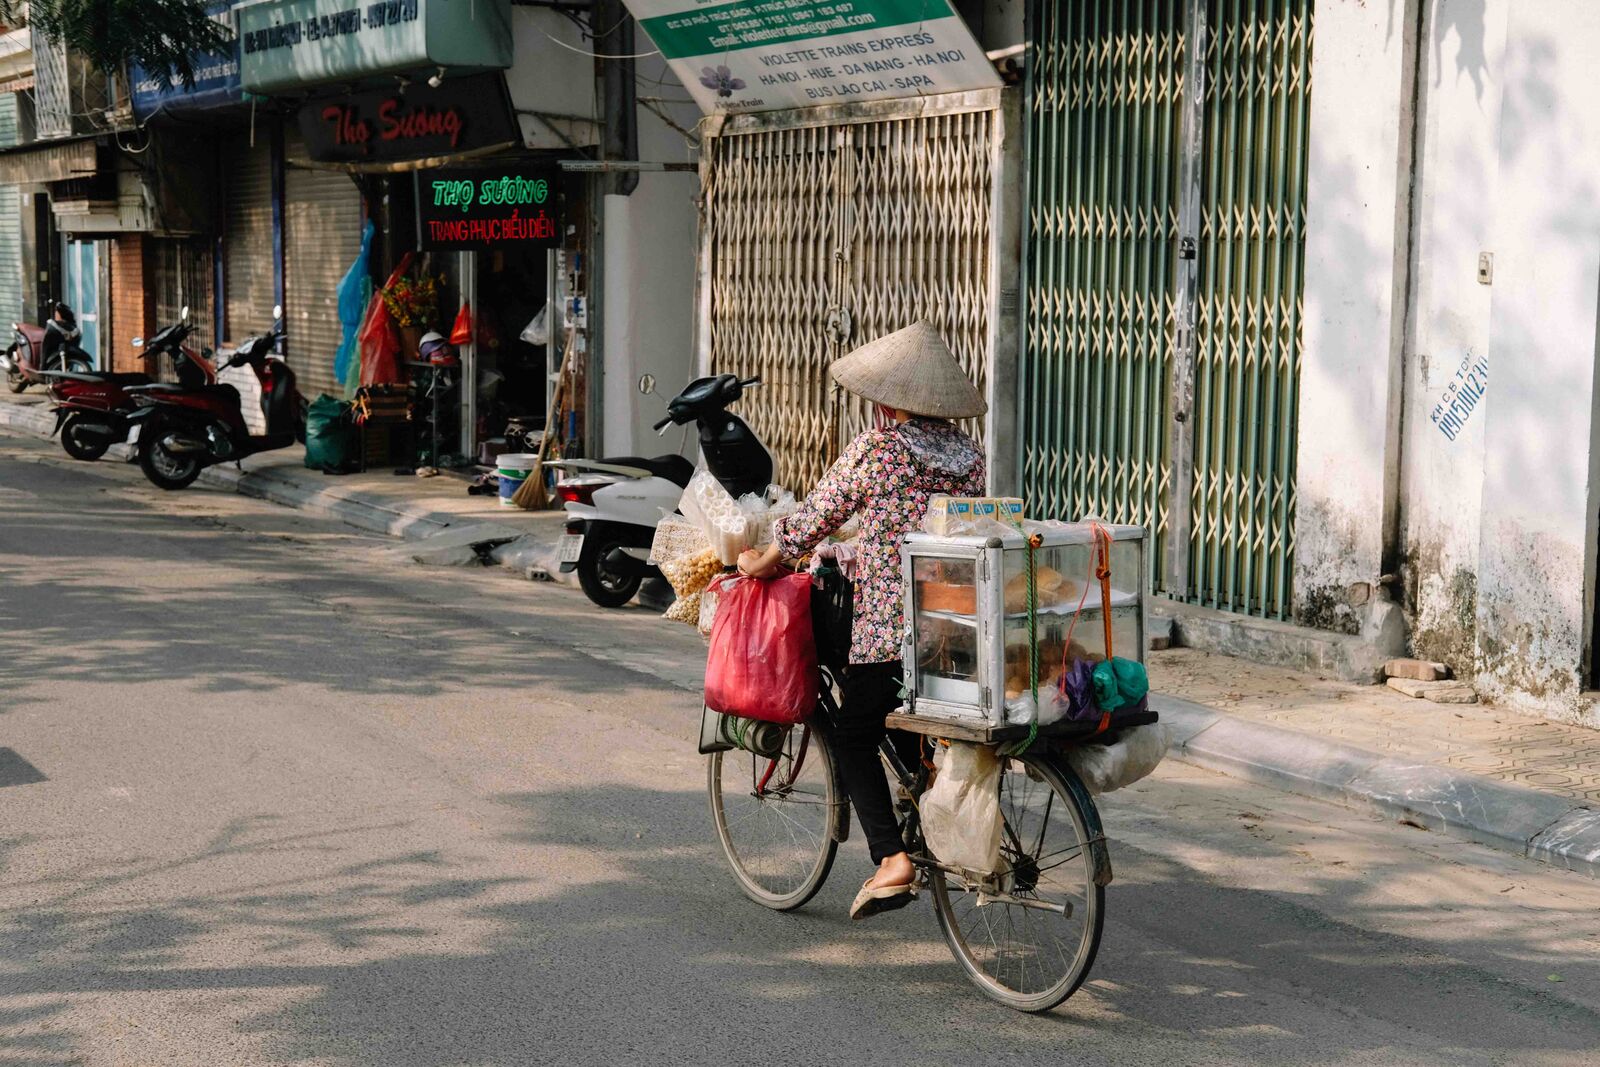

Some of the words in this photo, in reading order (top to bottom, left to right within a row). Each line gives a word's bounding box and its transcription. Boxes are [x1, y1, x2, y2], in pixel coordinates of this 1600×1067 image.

[739, 13, 877, 43] violettetrains@gmail.com
[759, 49, 819, 66] VIOLETTE
[817, 42, 868, 59] TRAINS
[867, 32, 935, 52] EXPRESS
[759, 73, 780, 85] HA
[777, 71, 802, 83] NOI
[807, 66, 836, 79] HUE
[842, 63, 865, 75] DA
[863, 57, 905, 72] NANG
[913, 53, 937, 66] HA
[936, 49, 966, 63] NOI
[805, 86, 834, 99] BUS
[832, 83, 861, 96] LAO
[862, 79, 887, 92] CAI
[894, 74, 936, 89] SAPA
[432, 180, 475, 212] THỌ
[479, 175, 548, 205] SƯƠNG
[428, 220, 469, 241] TRANG
[470, 219, 501, 245] PHỤC
